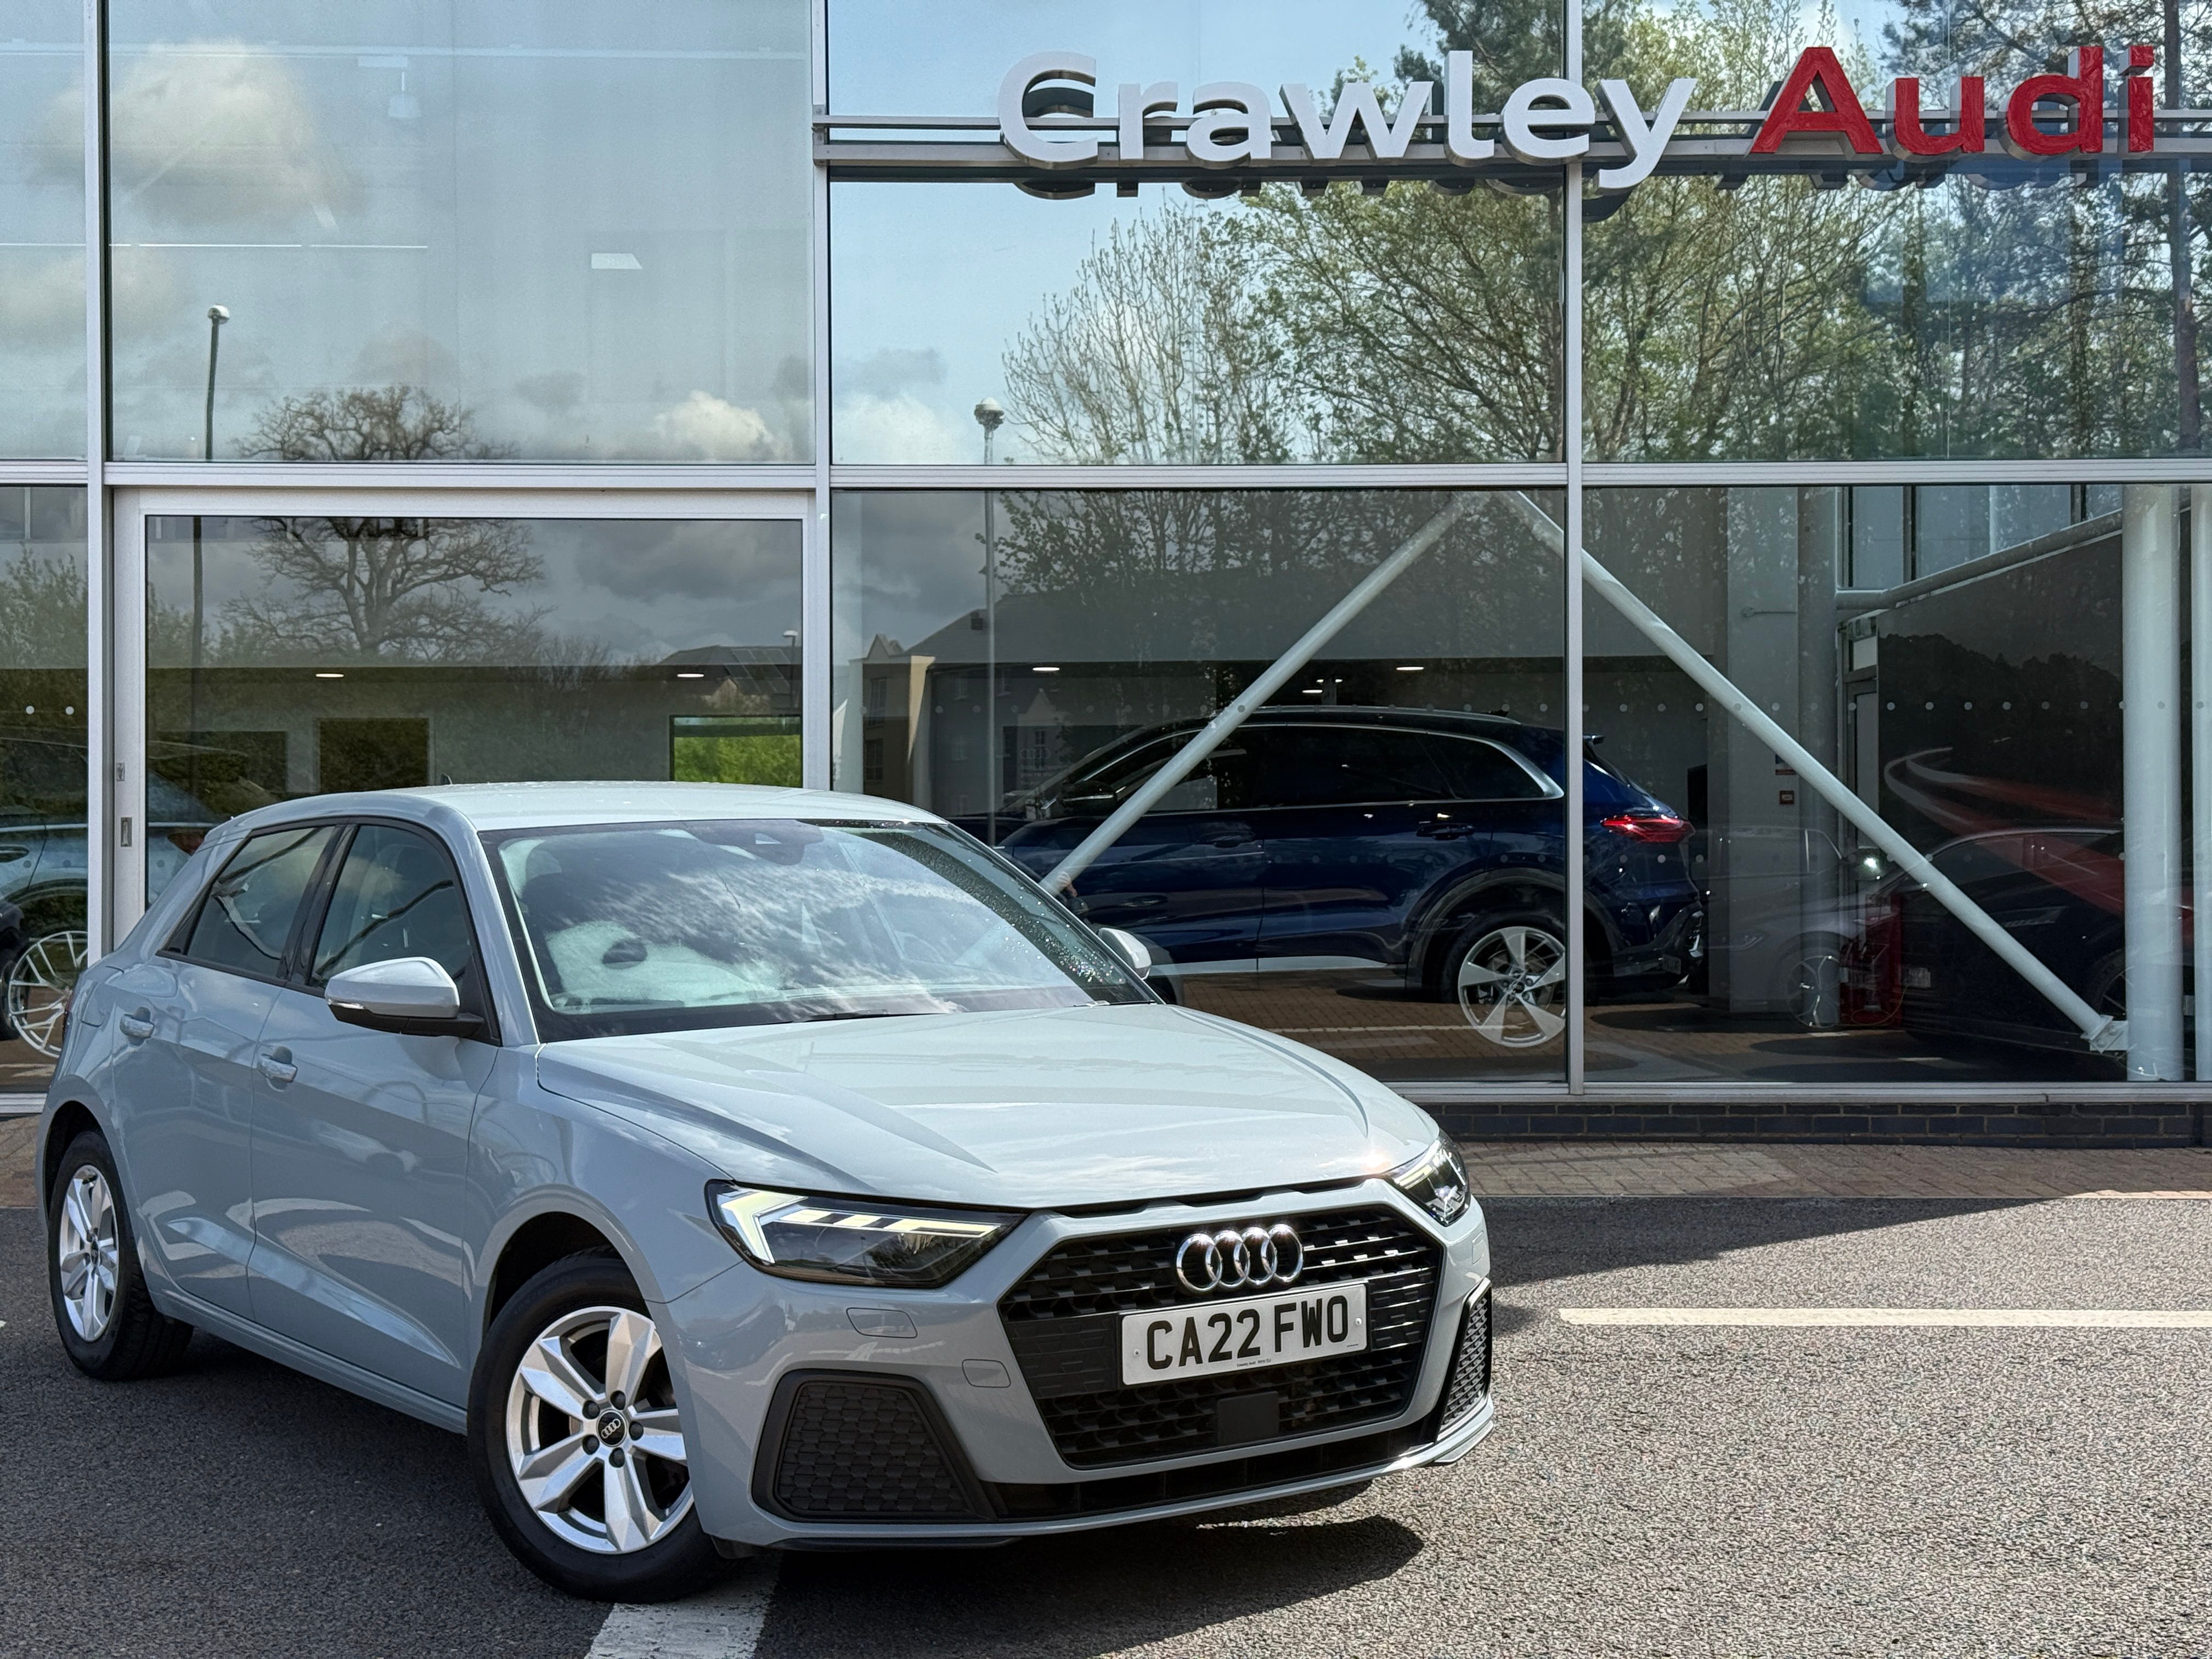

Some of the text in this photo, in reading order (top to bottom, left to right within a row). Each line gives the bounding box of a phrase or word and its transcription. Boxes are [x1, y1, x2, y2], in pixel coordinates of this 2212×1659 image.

[998, 46, 2155, 190] Crawley Audi
[1147, 1295, 1348, 1370] CA22 FWO
